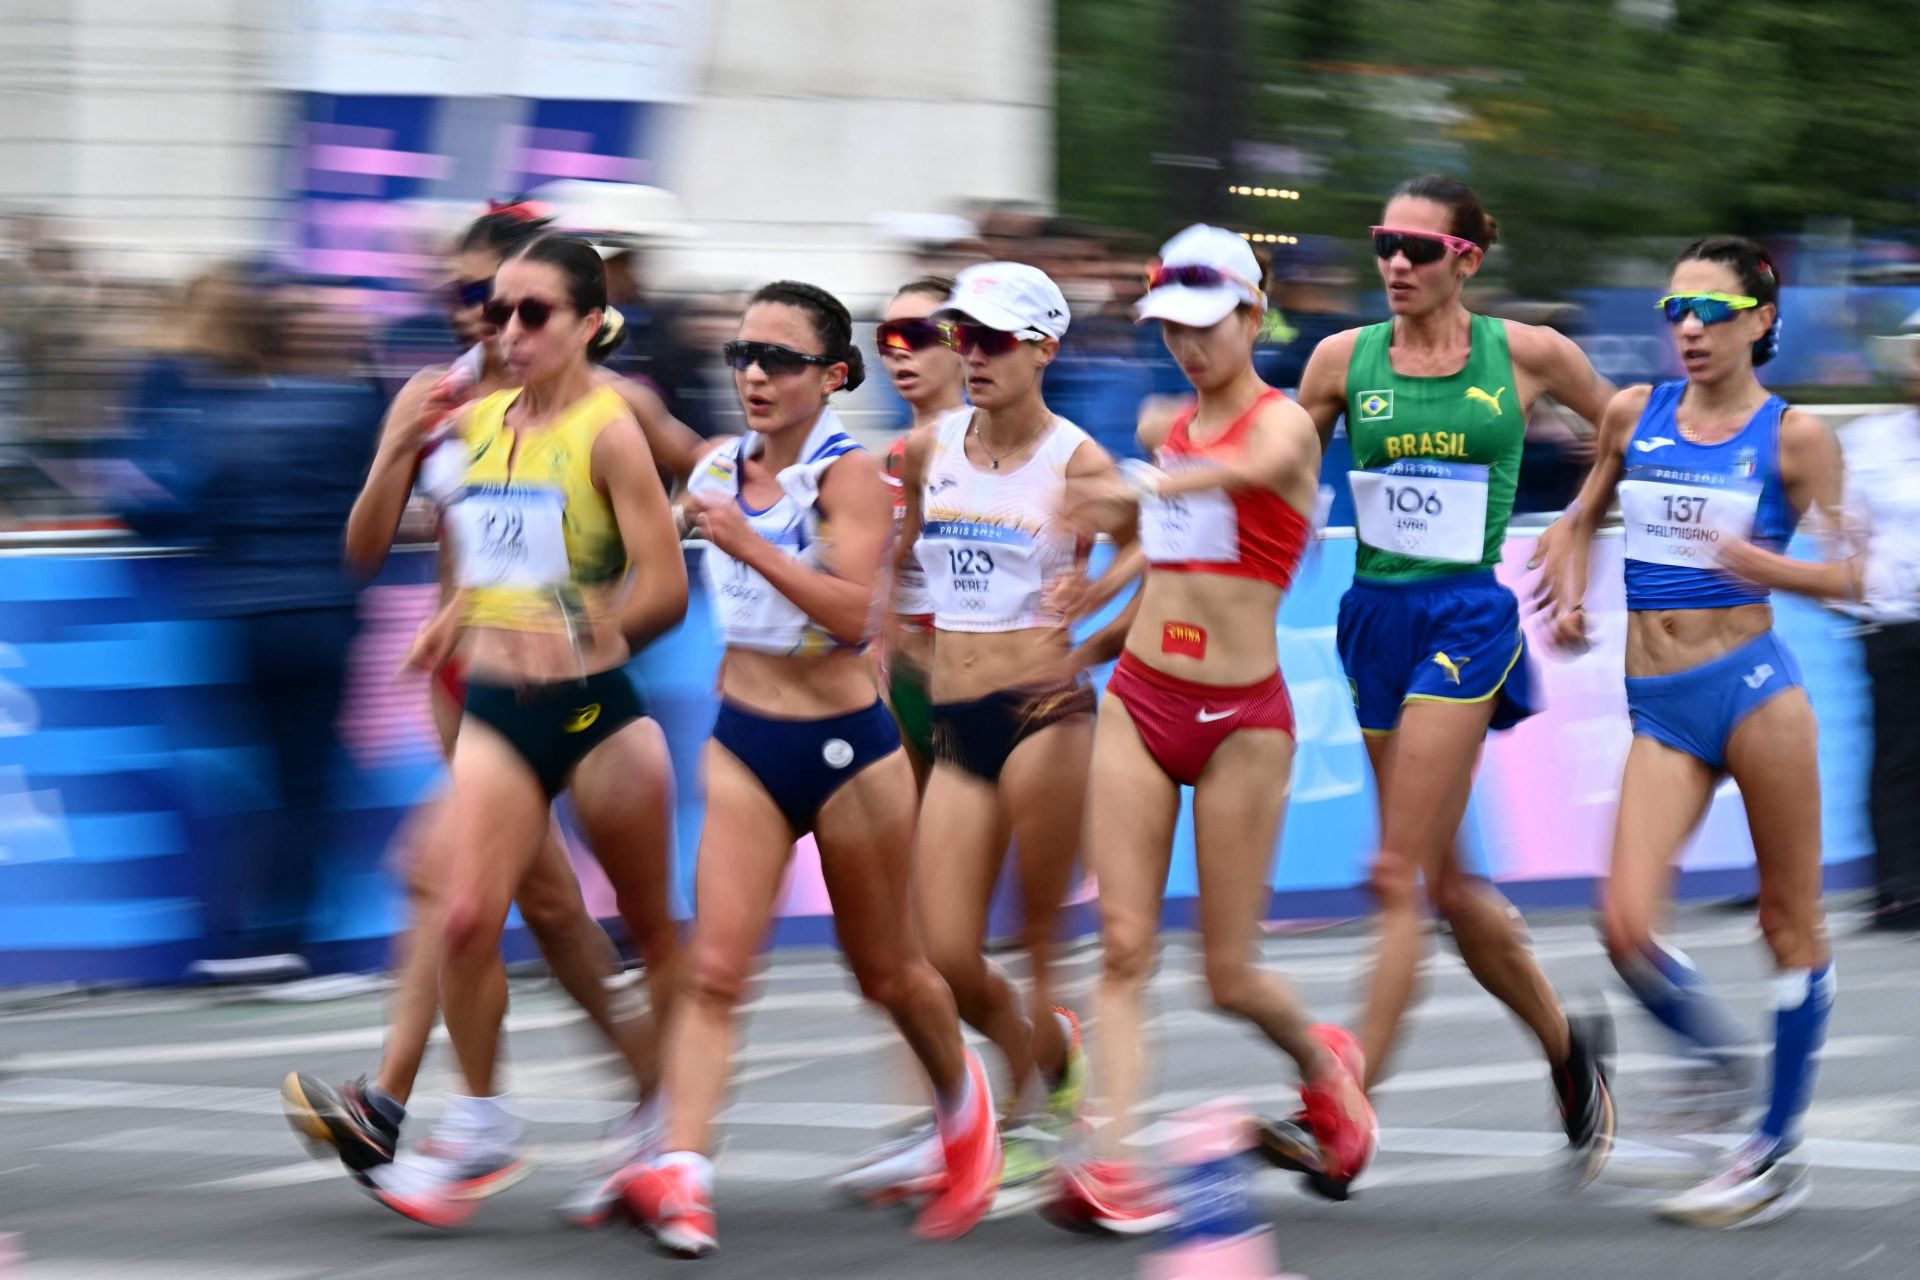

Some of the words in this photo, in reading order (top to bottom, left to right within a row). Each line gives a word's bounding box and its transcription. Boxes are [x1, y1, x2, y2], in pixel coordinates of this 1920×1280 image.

[1386, 431, 1468, 459] BRASIL
[1656, 469, 1690, 481] PARIS
[1385, 486, 1442, 517] 106
[1663, 495, 1708, 524] 137
[940, 526, 969, 536] PARIS
[972, 528, 1003, 539] 2024
[1647, 524, 1720, 542] PALMISANO
[949, 548, 994, 575] 123
[954, 579, 990, 593] PEREZ
[1167, 623, 1201, 645] CHINA
